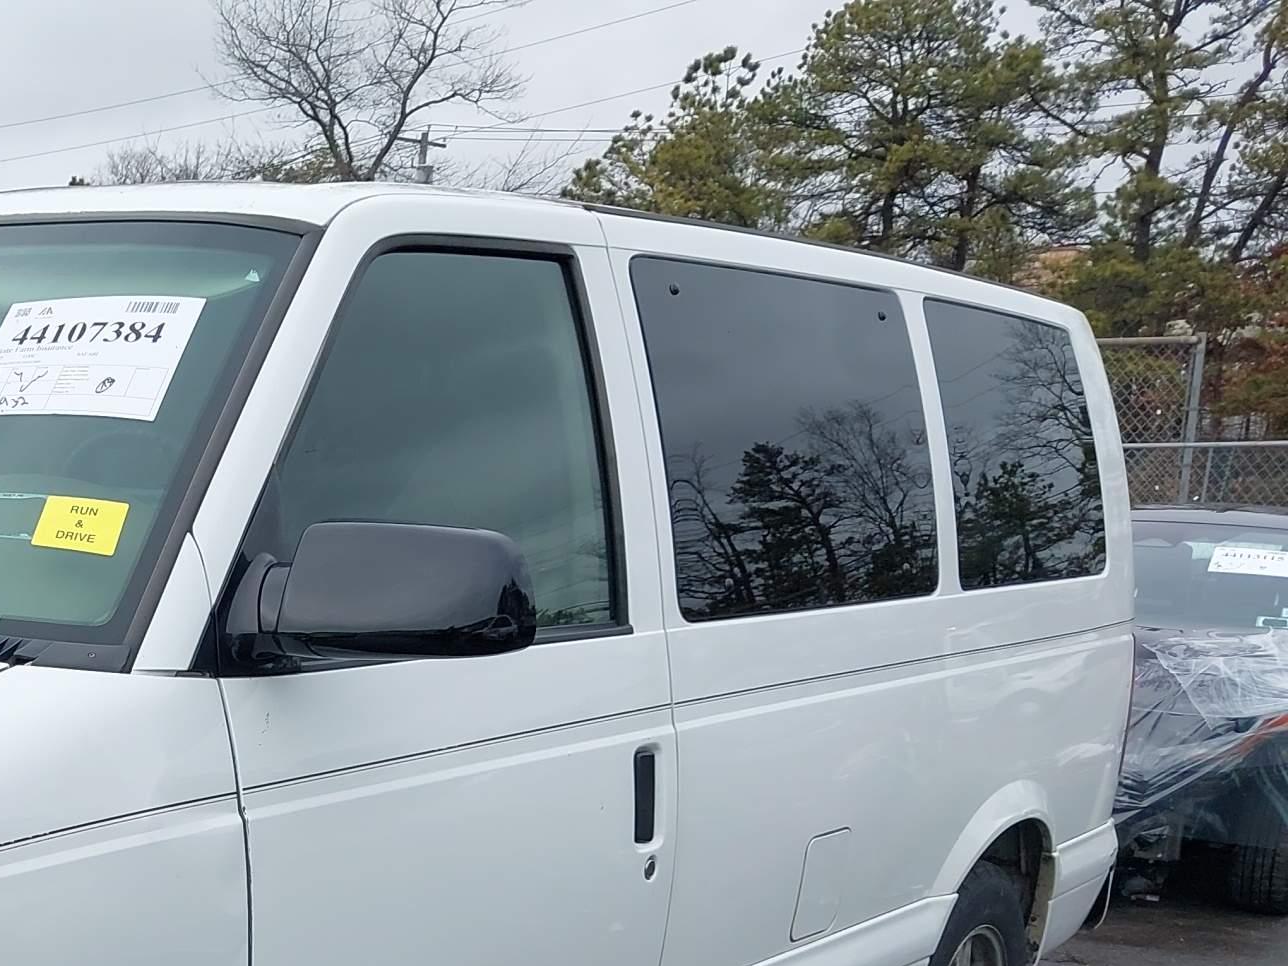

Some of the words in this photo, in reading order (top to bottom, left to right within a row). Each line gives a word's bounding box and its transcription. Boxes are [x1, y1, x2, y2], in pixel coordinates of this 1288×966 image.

[11, 321, 167, 346] 44107384
[70, 505, 99, 516] RUN
[75, 519, 84, 528] &
[55, 530, 97, 543] DRIVE
